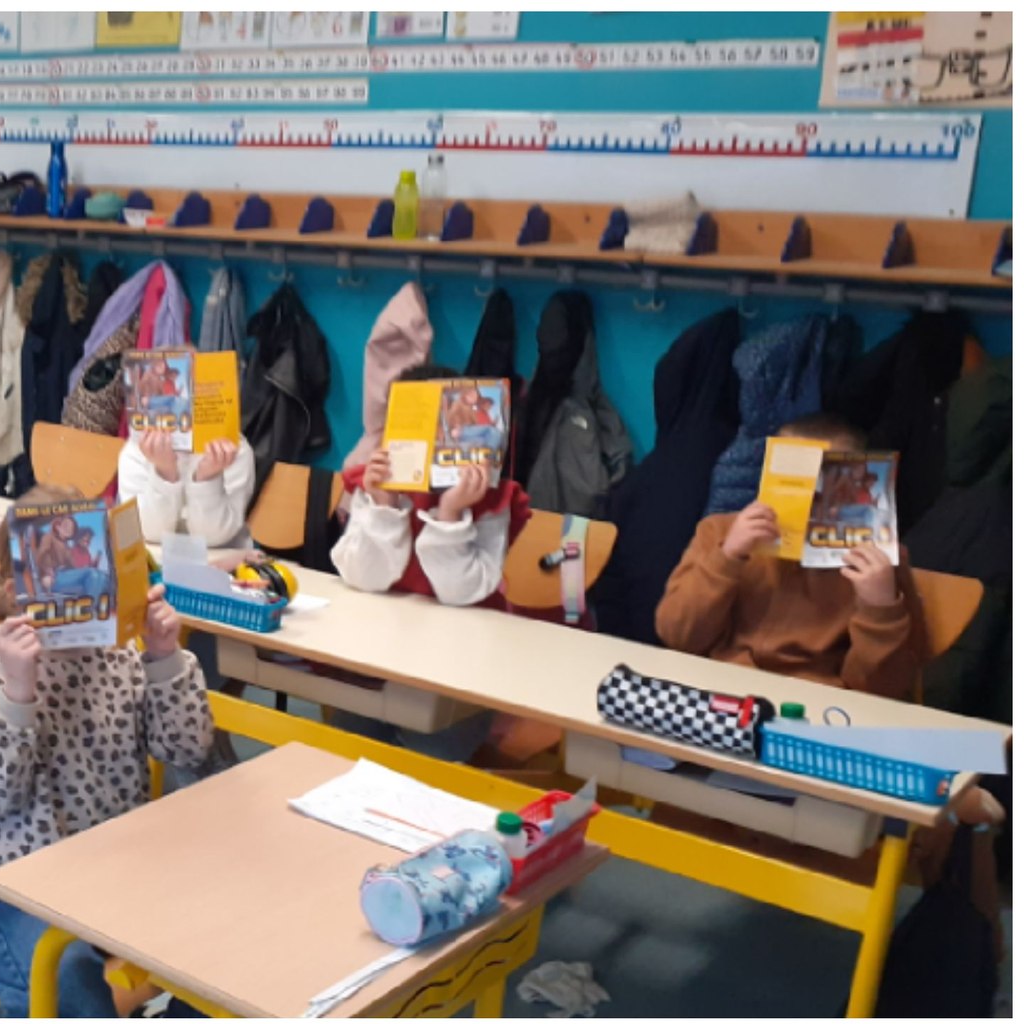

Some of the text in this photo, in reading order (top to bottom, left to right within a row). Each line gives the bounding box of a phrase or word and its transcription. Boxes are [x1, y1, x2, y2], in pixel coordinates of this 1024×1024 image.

[577, 50, 594, 64] 50
[600, 50, 614, 63] 51
[624, 49, 640, 62] 52
[647, 48, 663, 62] 53
[671, 48, 686, 61] 54
[695, 47, 711, 61] 55
[720, 47, 737, 61] 56
[744, 47, 762, 60] 57
[770, 46, 788, 60] 58
[796, 46, 815, 60] 59
[540, 120, 557, 131] 70
[796, 123, 817, 135] 90
[943, 123, 975, 137] 100
